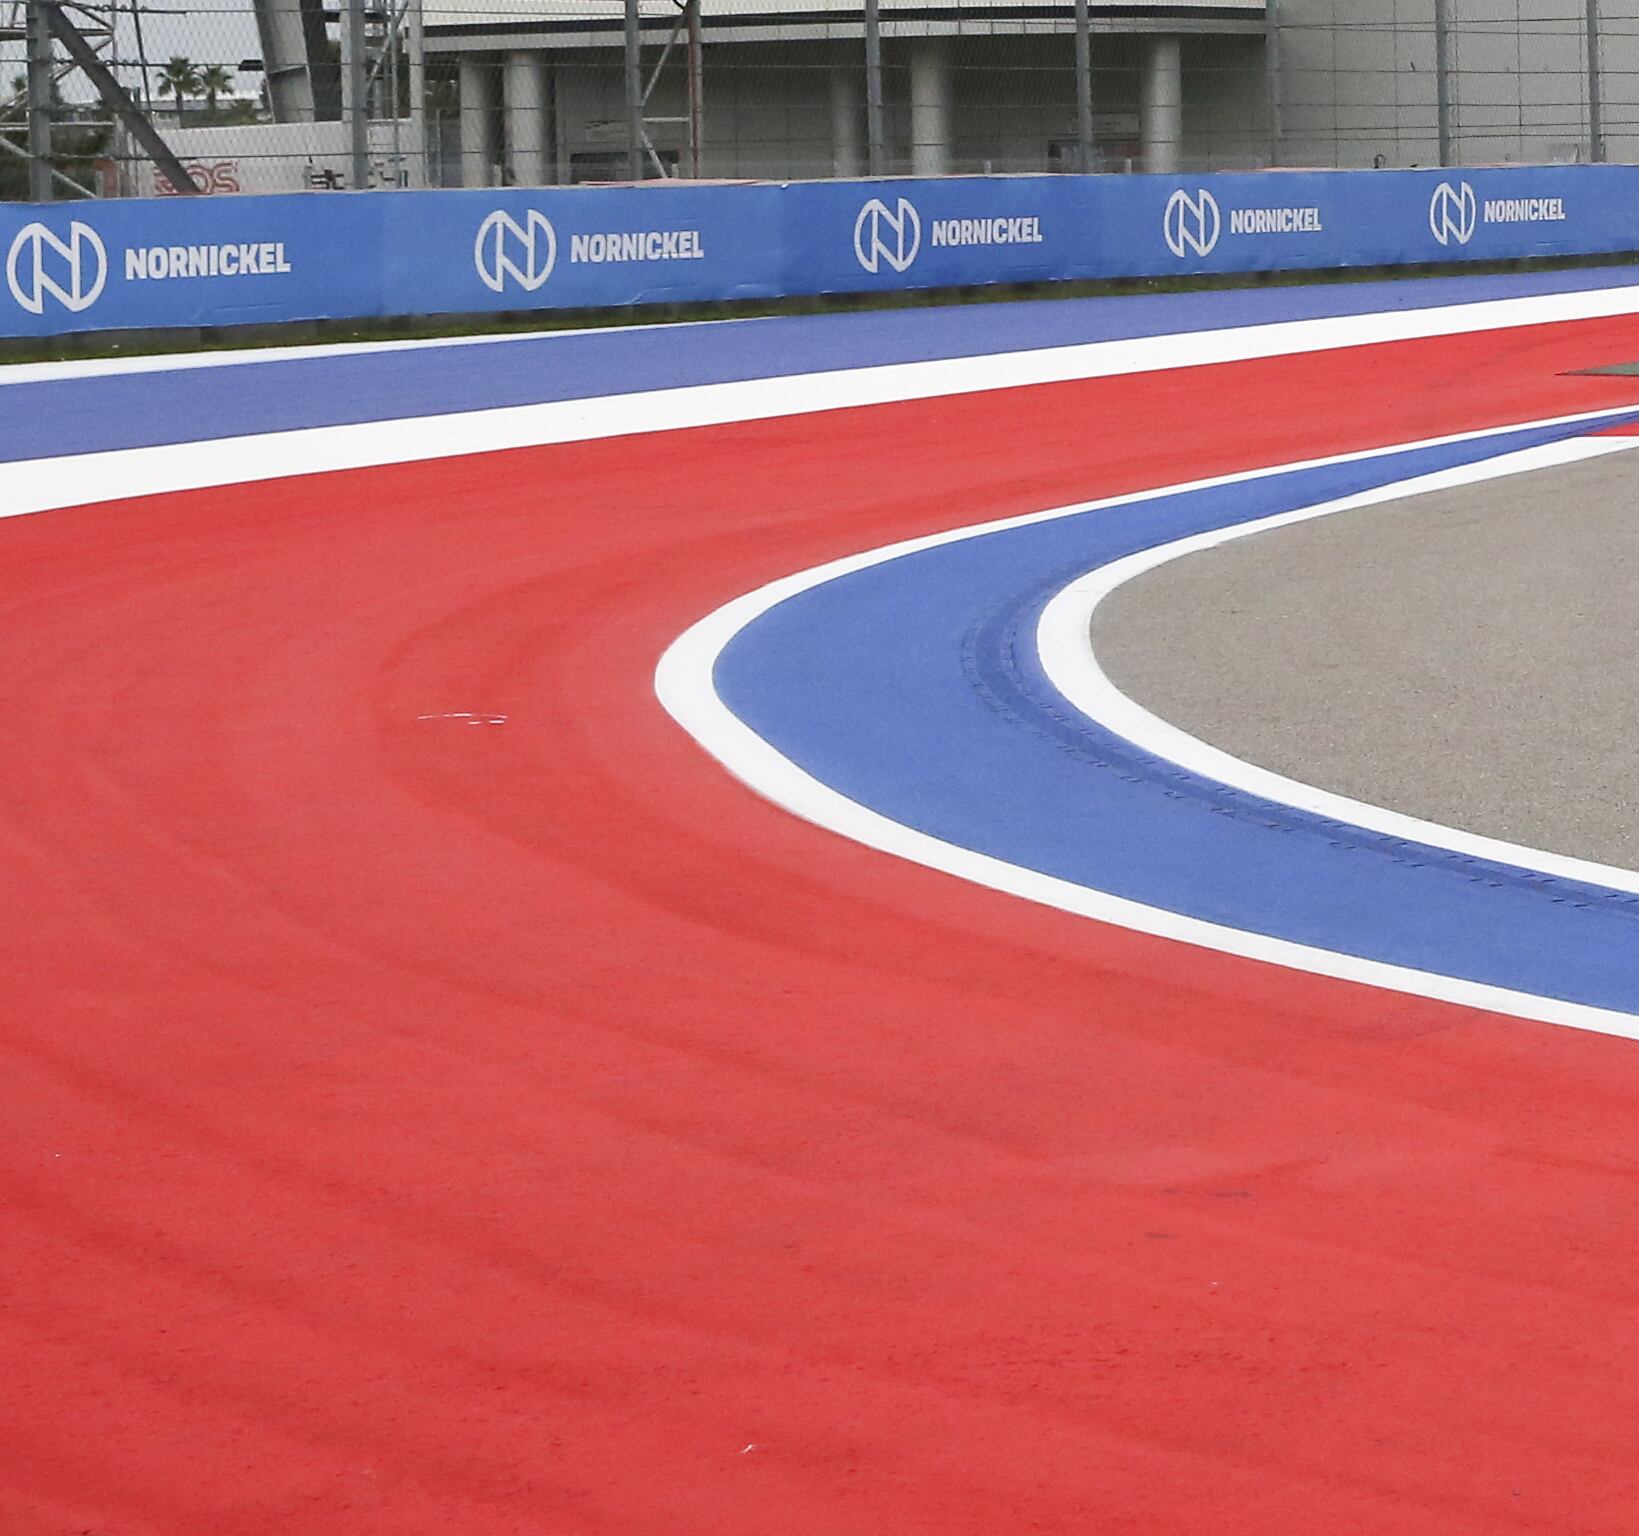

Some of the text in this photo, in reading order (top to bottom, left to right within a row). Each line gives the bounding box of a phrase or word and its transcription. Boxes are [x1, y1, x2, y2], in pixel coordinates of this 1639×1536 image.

[1231, 208, 1322, 233] NORNICKEL
[1484, 199, 1565, 222] NORNICKEL
[932, 218, 1042, 246] NORNICKEL
[571, 231, 704, 262] NORNICKEL
[126, 243, 291, 279] NORNICKEL
